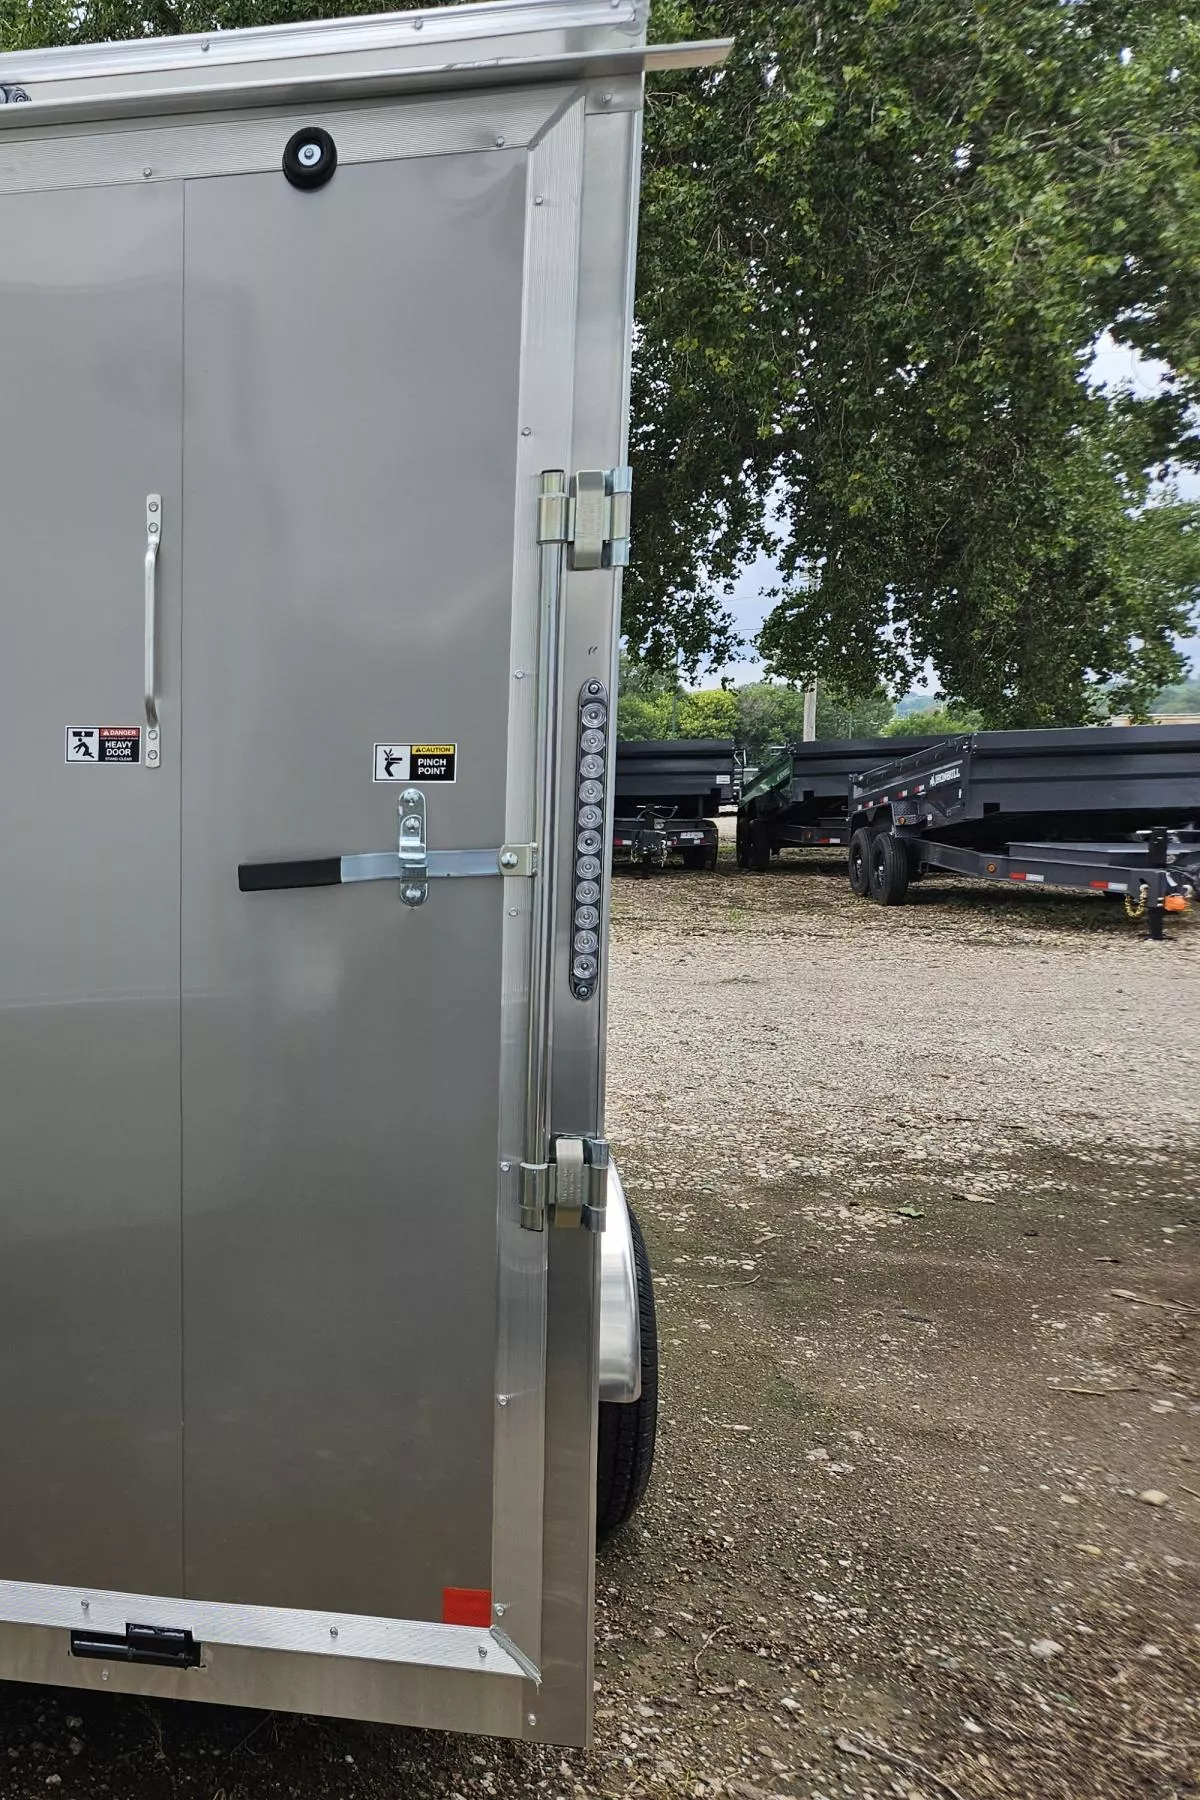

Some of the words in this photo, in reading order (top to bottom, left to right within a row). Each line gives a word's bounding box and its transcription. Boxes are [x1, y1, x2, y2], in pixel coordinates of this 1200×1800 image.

[106, 748, 131, 756] DOOR
[418, 758, 447, 766] PINCH
[418, 767, 447, 775] POINT
